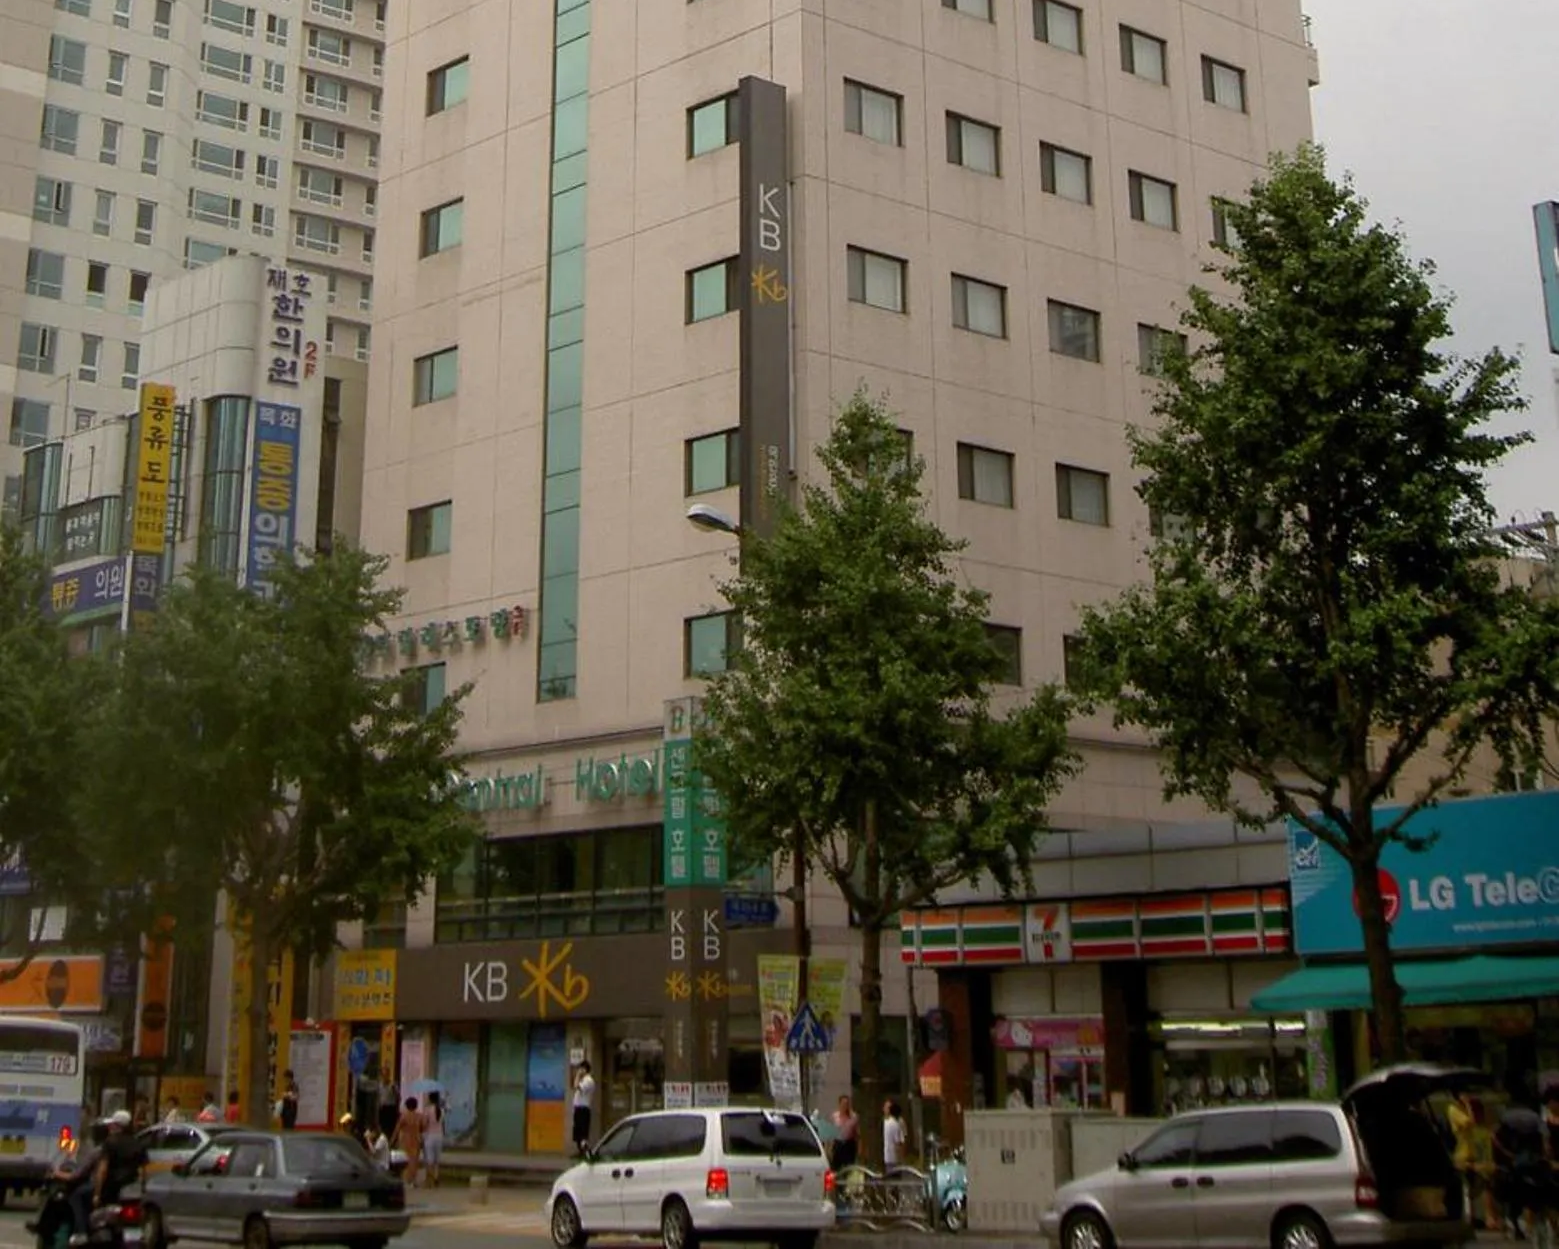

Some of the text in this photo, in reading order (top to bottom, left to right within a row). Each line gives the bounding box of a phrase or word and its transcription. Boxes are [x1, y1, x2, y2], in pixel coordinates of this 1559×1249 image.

[760, 183, 781, 251] KB
[267, 268, 312, 297] 재호
[268, 293, 305, 388] 한의원
[141, 396, 171, 483] 풍류도
[94, 565, 124, 599] 의원
[574, 749, 665, 801] Hotel
[1408, 877, 1456, 912] LG
[671, 909, 686, 960] KB
[703, 909, 721, 960] KB
[463, 961, 508, 1003] KB
